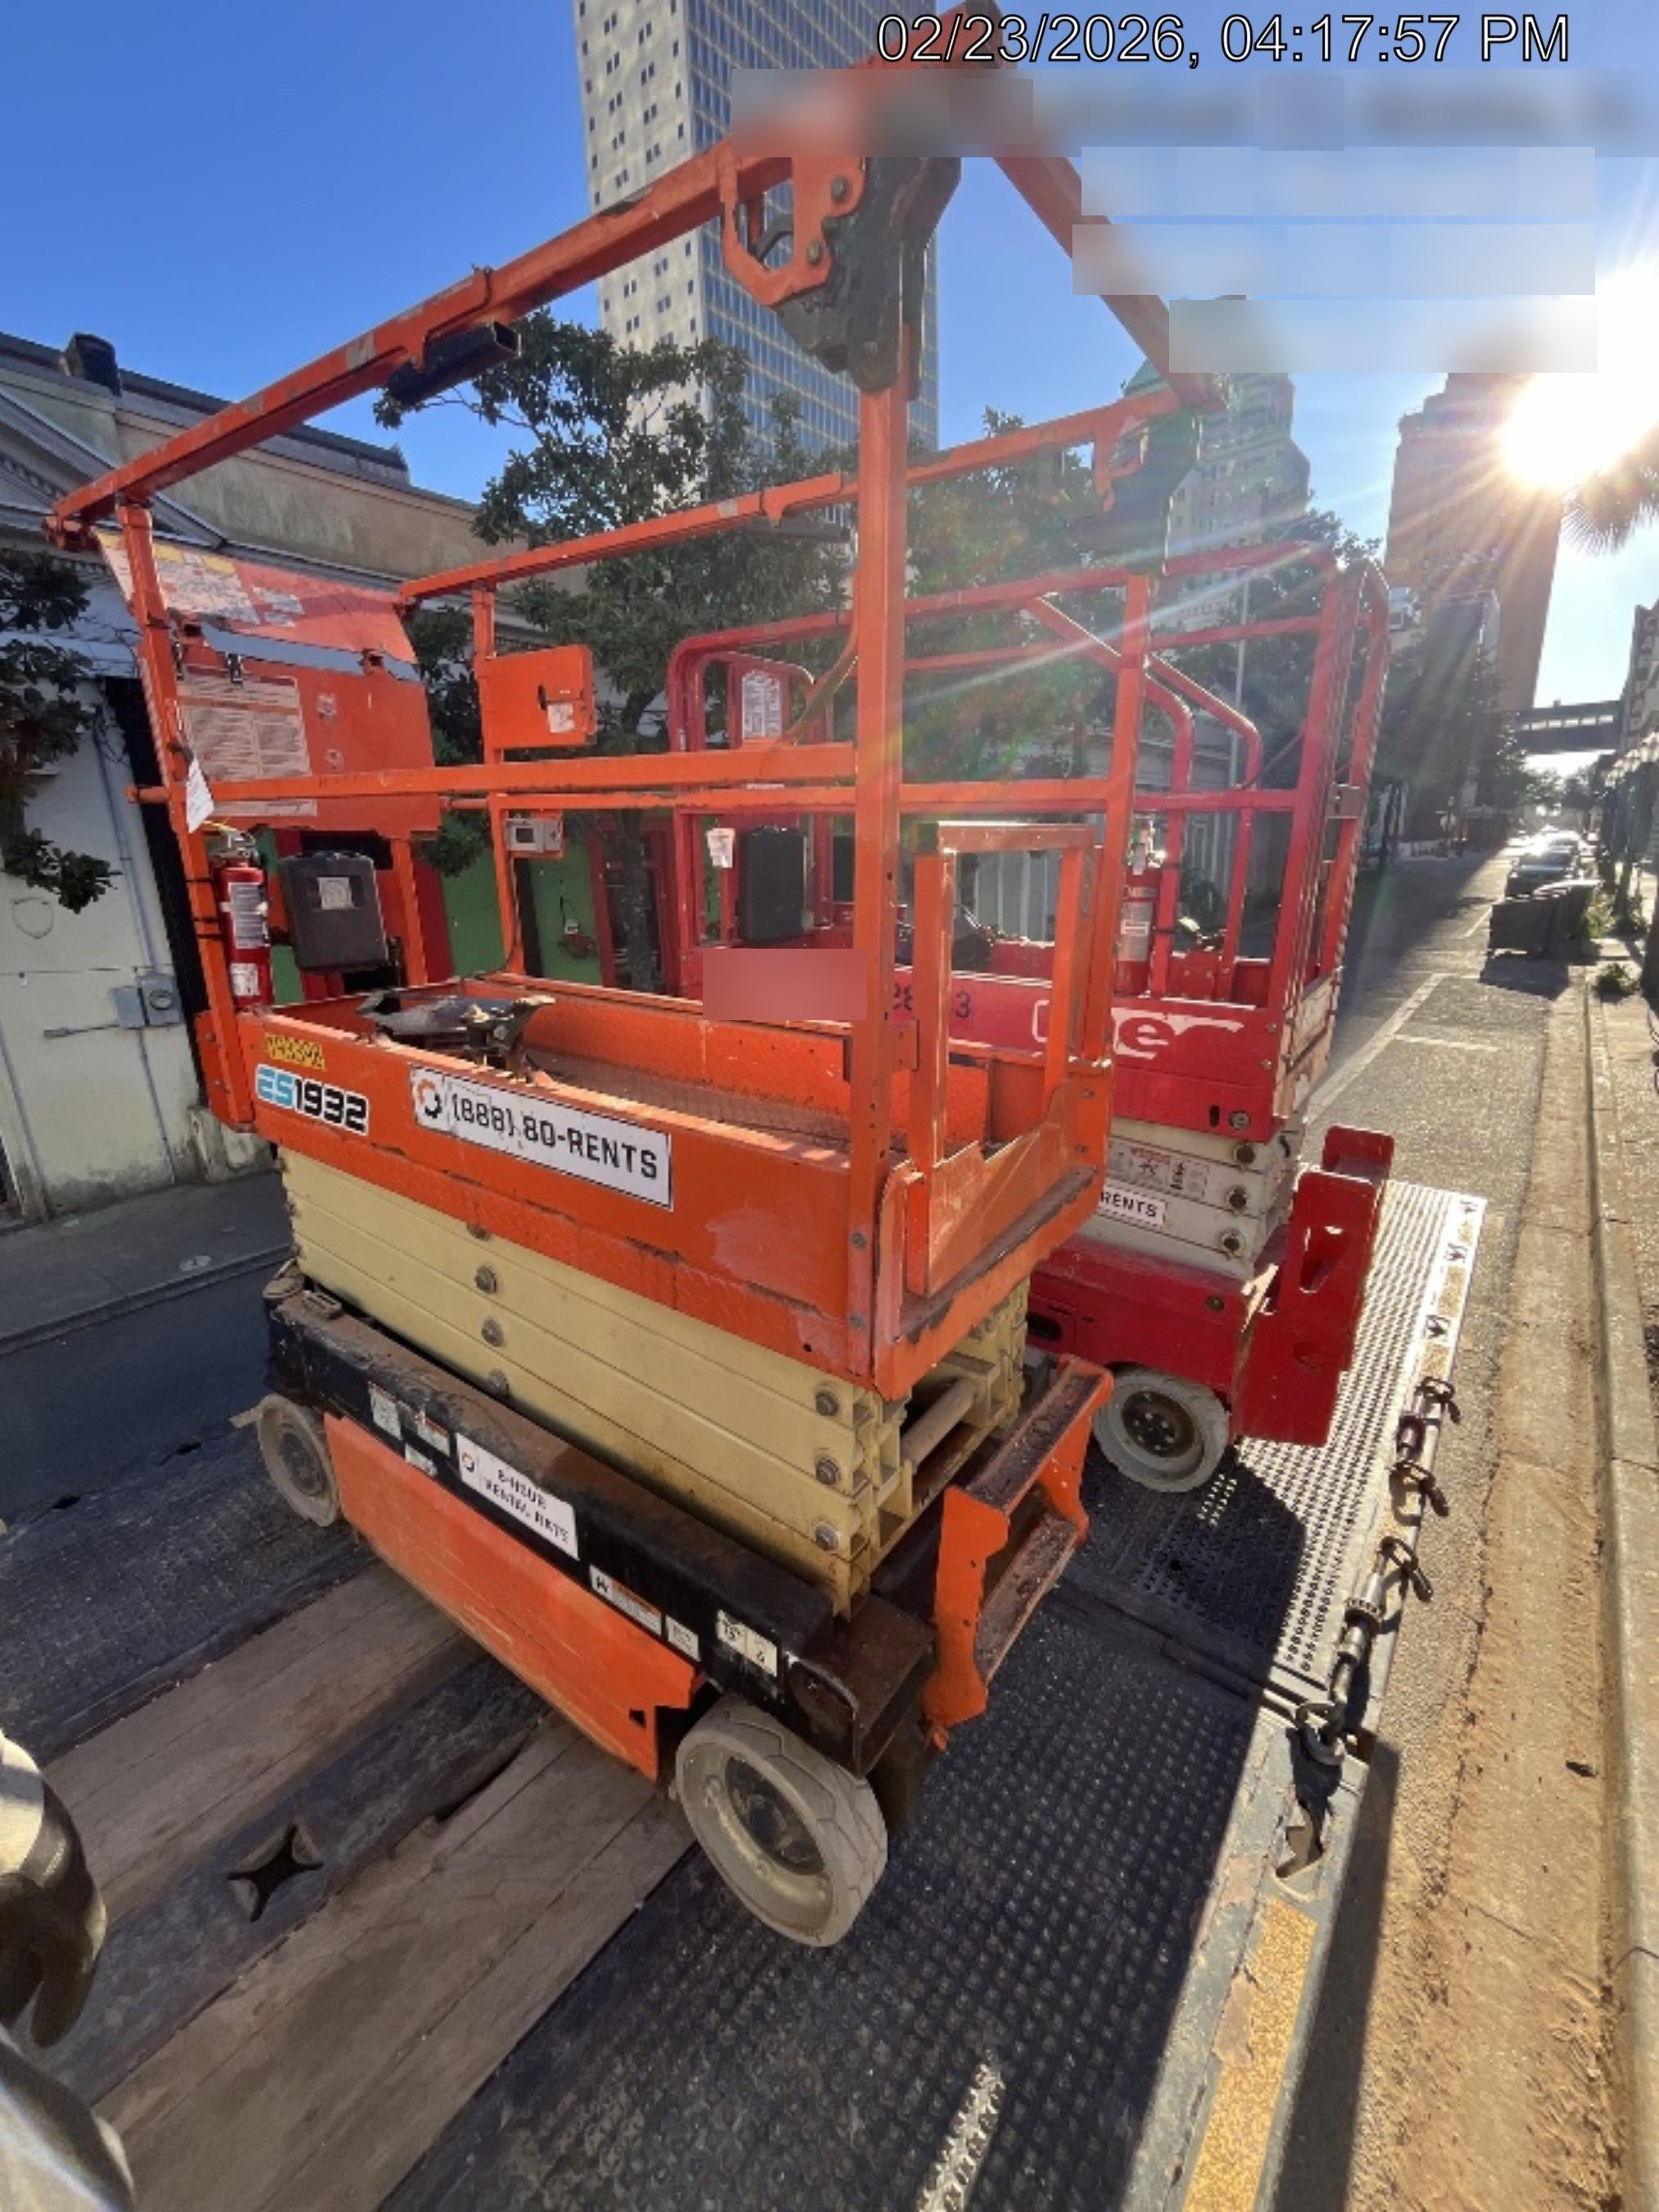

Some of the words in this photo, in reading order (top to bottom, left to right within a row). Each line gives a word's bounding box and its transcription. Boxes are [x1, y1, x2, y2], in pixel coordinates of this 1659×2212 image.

[257, 1065, 368, 1134] ES1932
[452, 1094, 515, 1137] (888)
[522, 1115, 657, 1180] 80-RENTS
